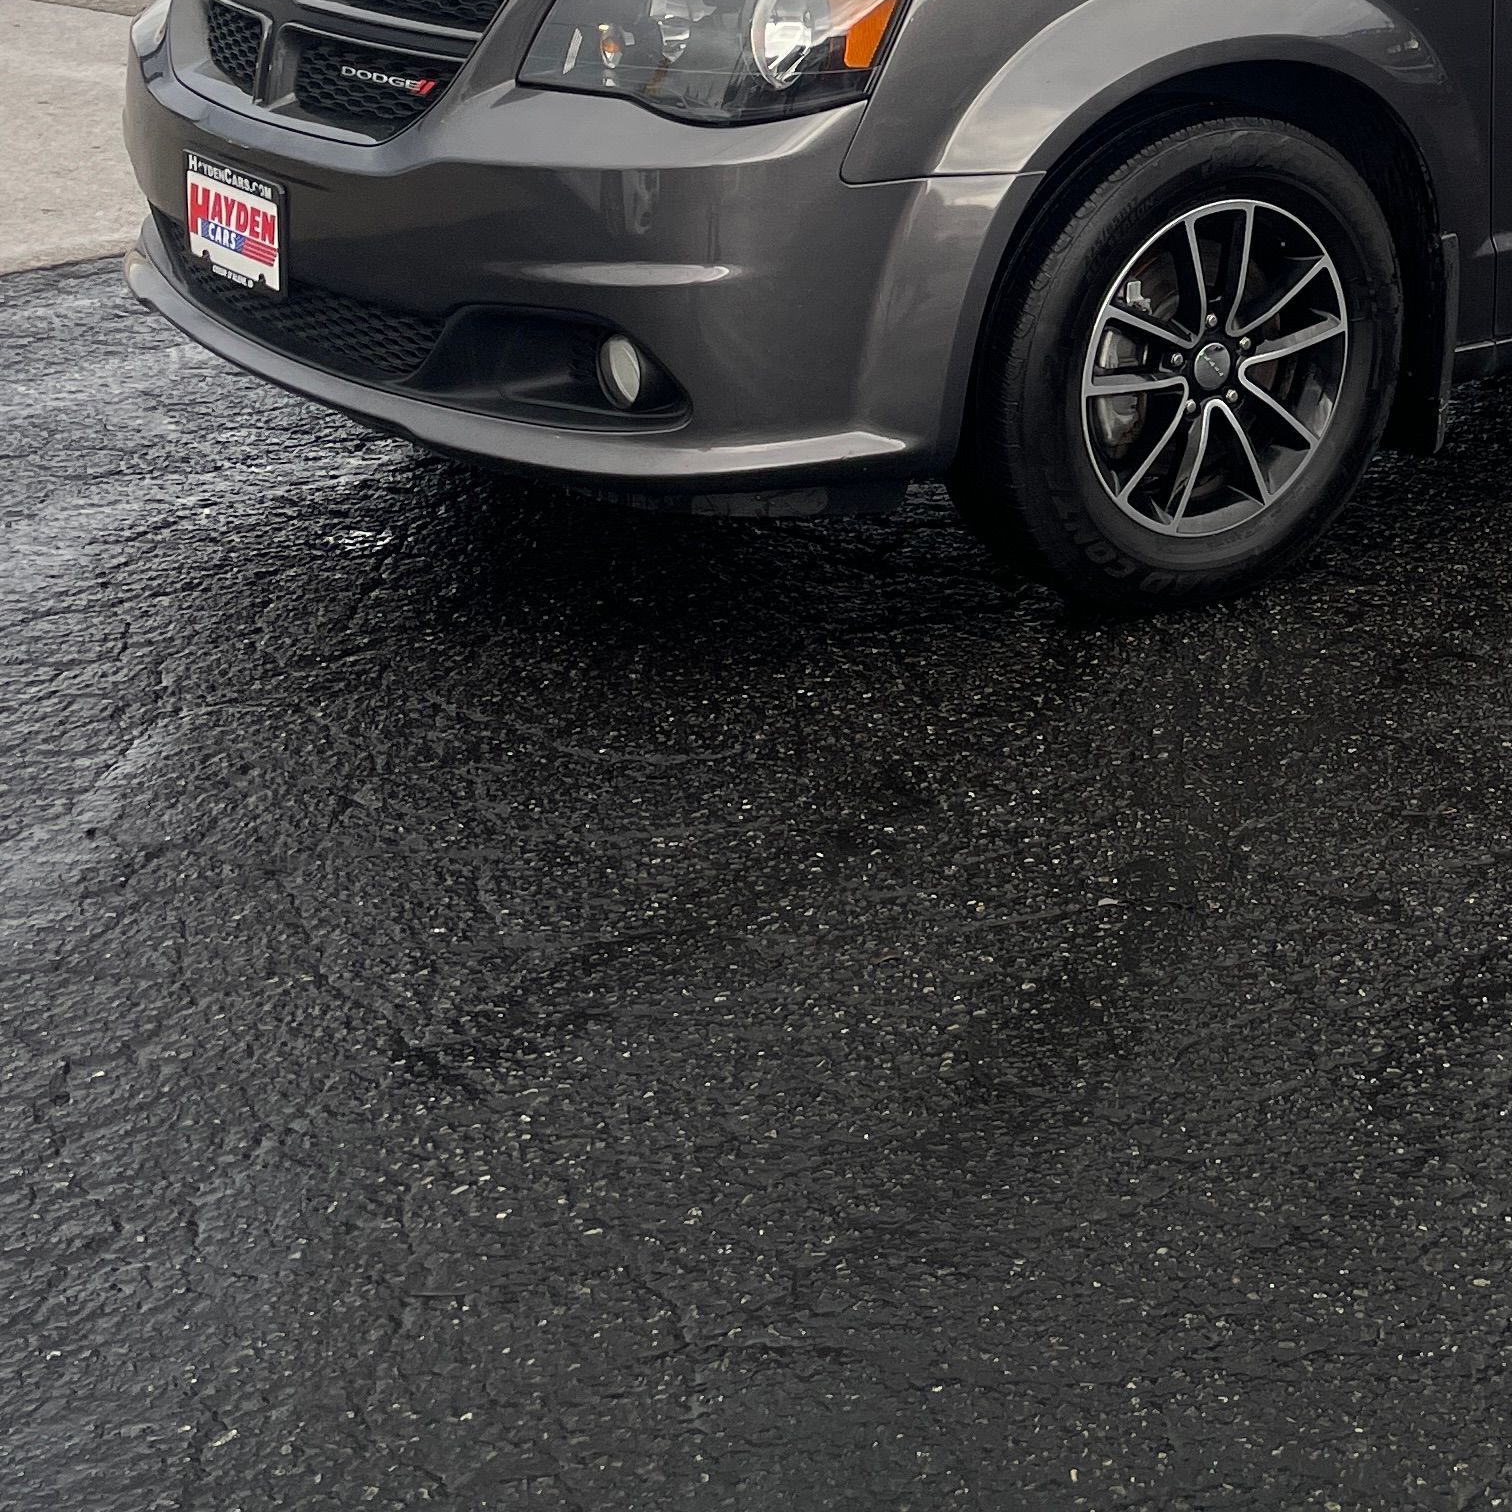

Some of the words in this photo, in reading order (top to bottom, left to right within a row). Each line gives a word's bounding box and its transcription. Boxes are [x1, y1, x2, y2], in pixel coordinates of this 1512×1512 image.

[341, 66, 421, 91] DODGE
[190, 182, 276, 246] HAYDEN
[208, 223, 236, 250] CARS
